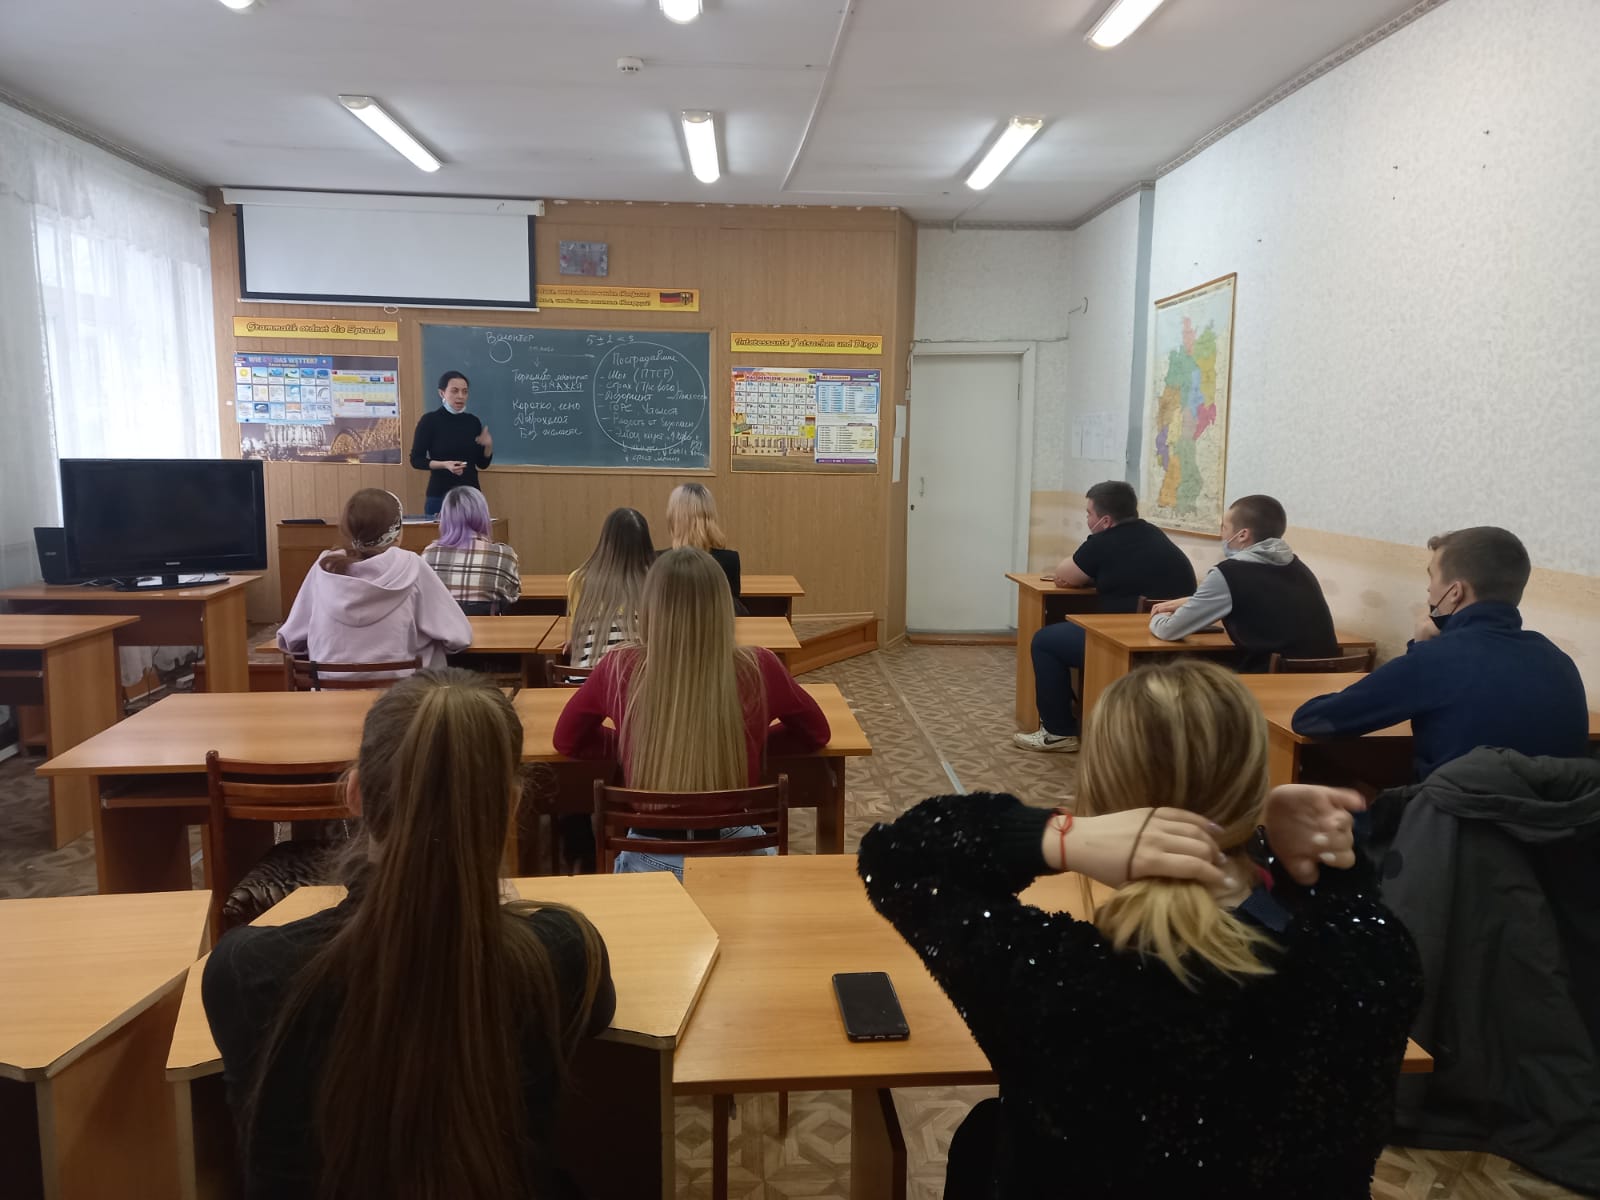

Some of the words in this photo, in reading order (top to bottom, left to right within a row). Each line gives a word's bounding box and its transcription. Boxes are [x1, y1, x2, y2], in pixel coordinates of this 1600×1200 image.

[246, 321, 298, 333] Grammatik
[331, 325, 345, 334] die
[347, 326, 385, 336] Sprache
